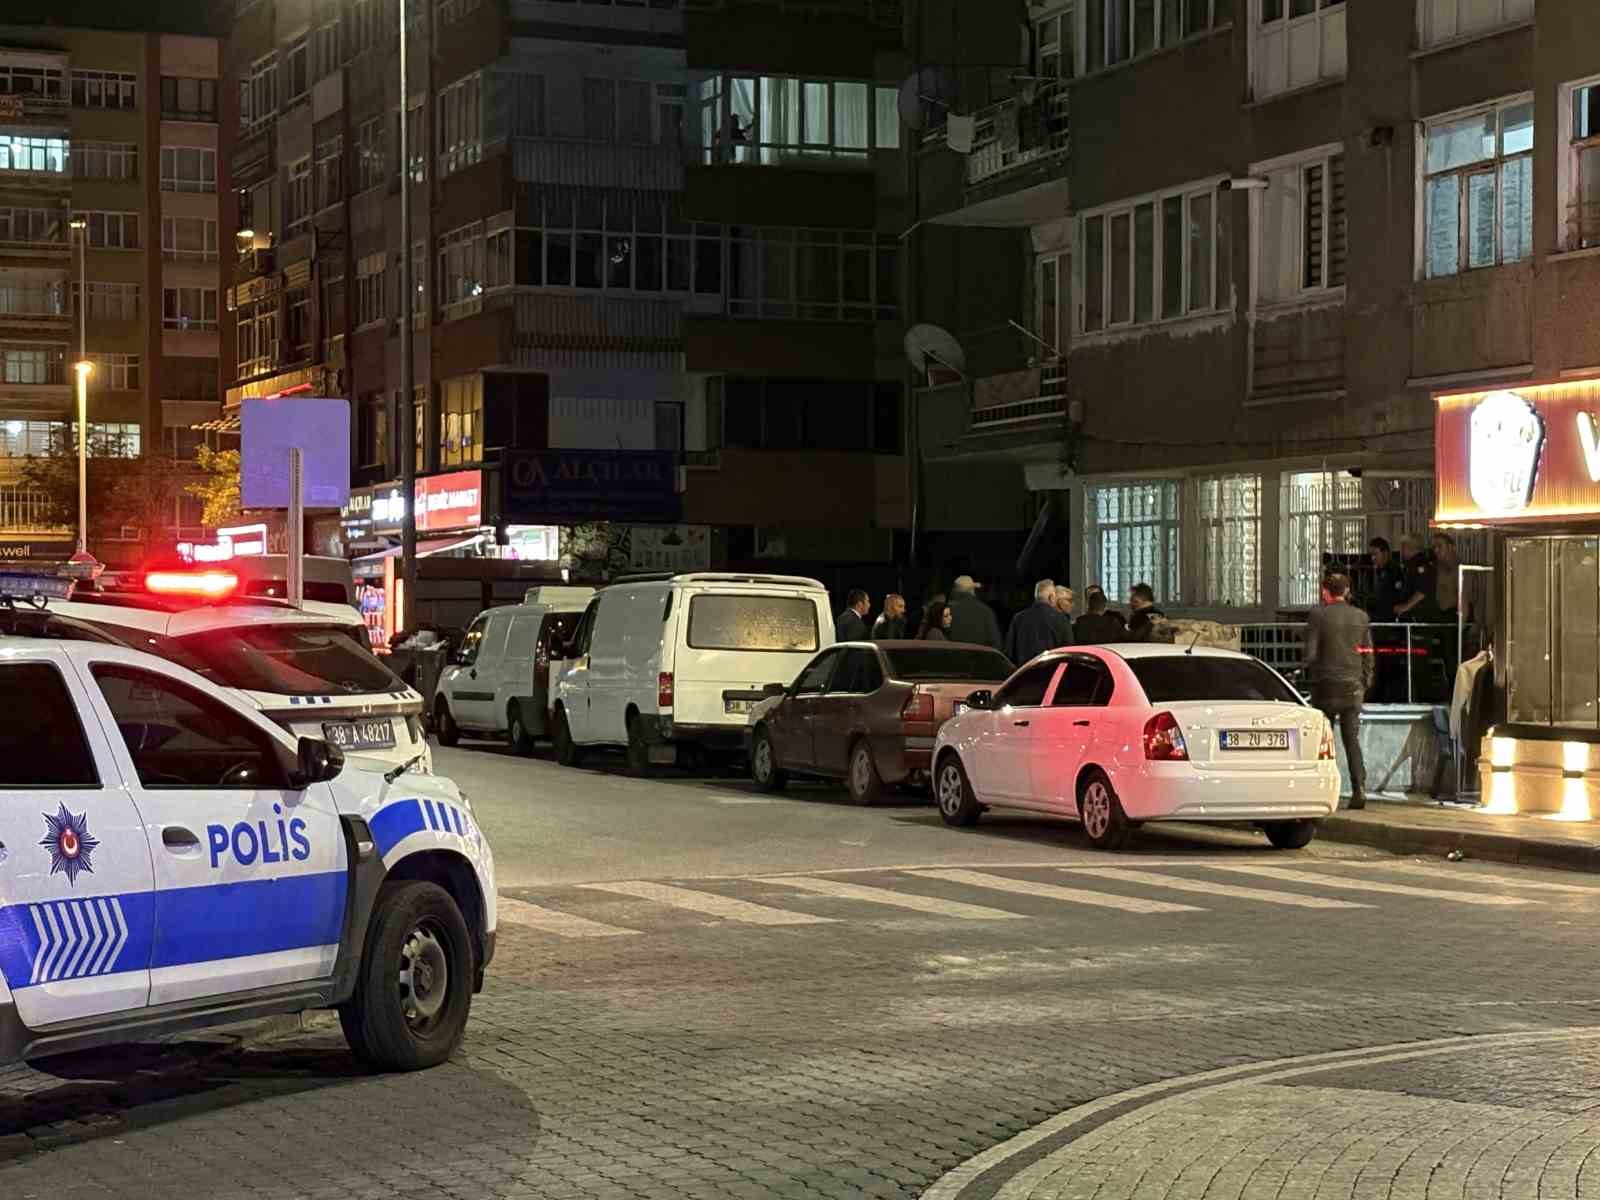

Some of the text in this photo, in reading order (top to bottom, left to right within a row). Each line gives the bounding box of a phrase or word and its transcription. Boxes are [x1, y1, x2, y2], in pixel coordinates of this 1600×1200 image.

[332, 723, 390, 744] 38 A 48217
[1228, 733, 1286, 746] 38 ZU 378
[207, 803, 310, 868] POLİS
